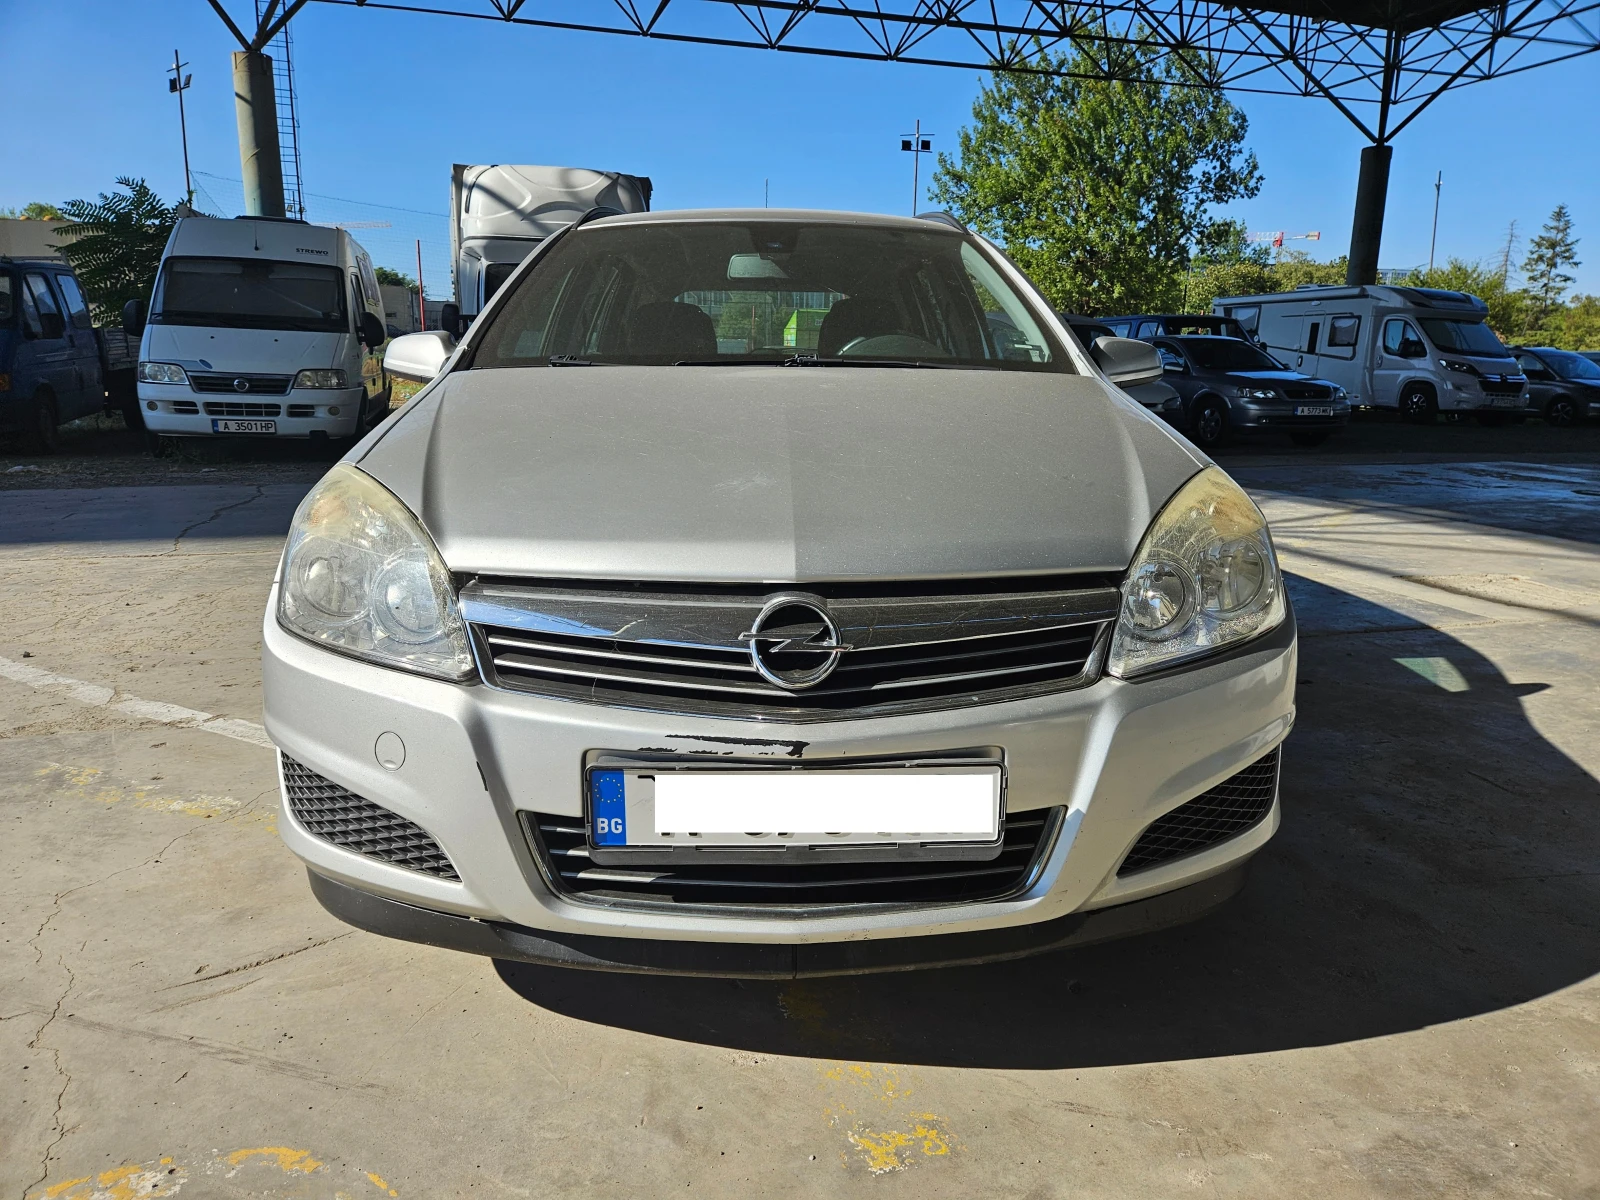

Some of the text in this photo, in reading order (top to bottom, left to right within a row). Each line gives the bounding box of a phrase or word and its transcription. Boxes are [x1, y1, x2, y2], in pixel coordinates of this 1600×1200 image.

[295, 247, 329, 255] STREWO
[223, 421, 230, 431] A
[596, 817, 623, 834] BG
